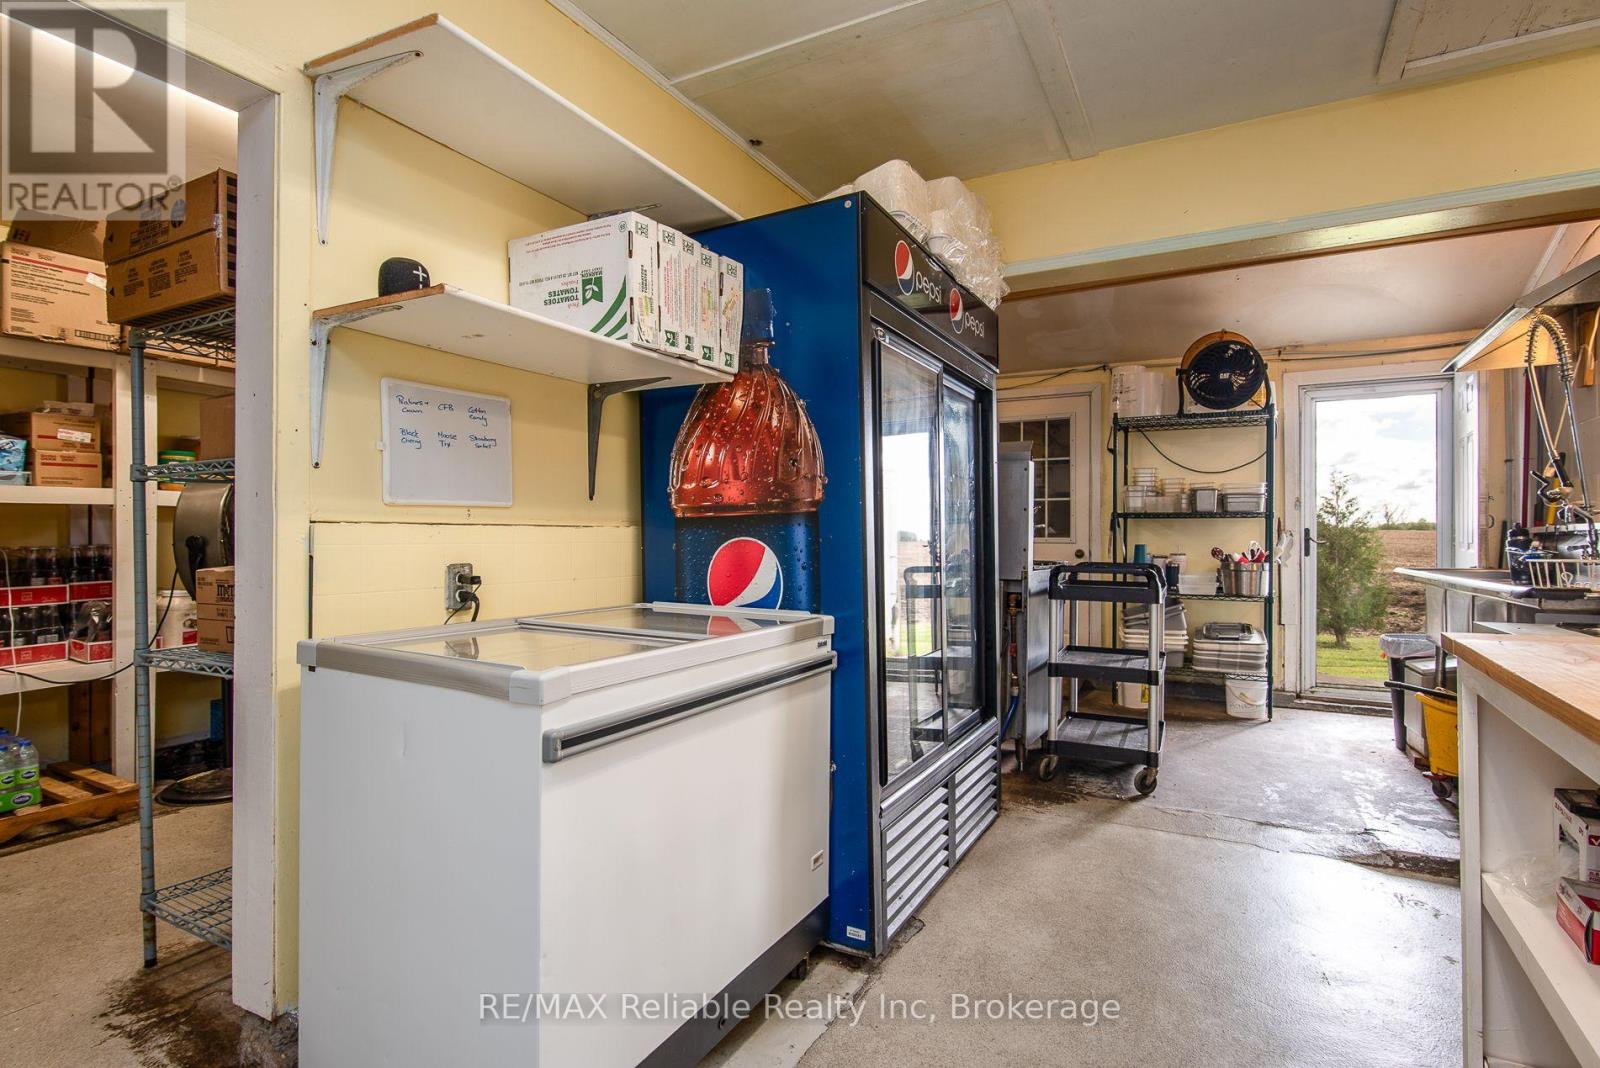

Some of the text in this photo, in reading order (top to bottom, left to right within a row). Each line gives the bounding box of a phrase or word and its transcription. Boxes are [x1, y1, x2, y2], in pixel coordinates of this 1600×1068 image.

[548, 286, 579, 298] TOMATES
[915, 271, 942, 304] pepsi
[543, 294, 579, 306] TOMATOES
[964, 312, 985, 338] pepsi
